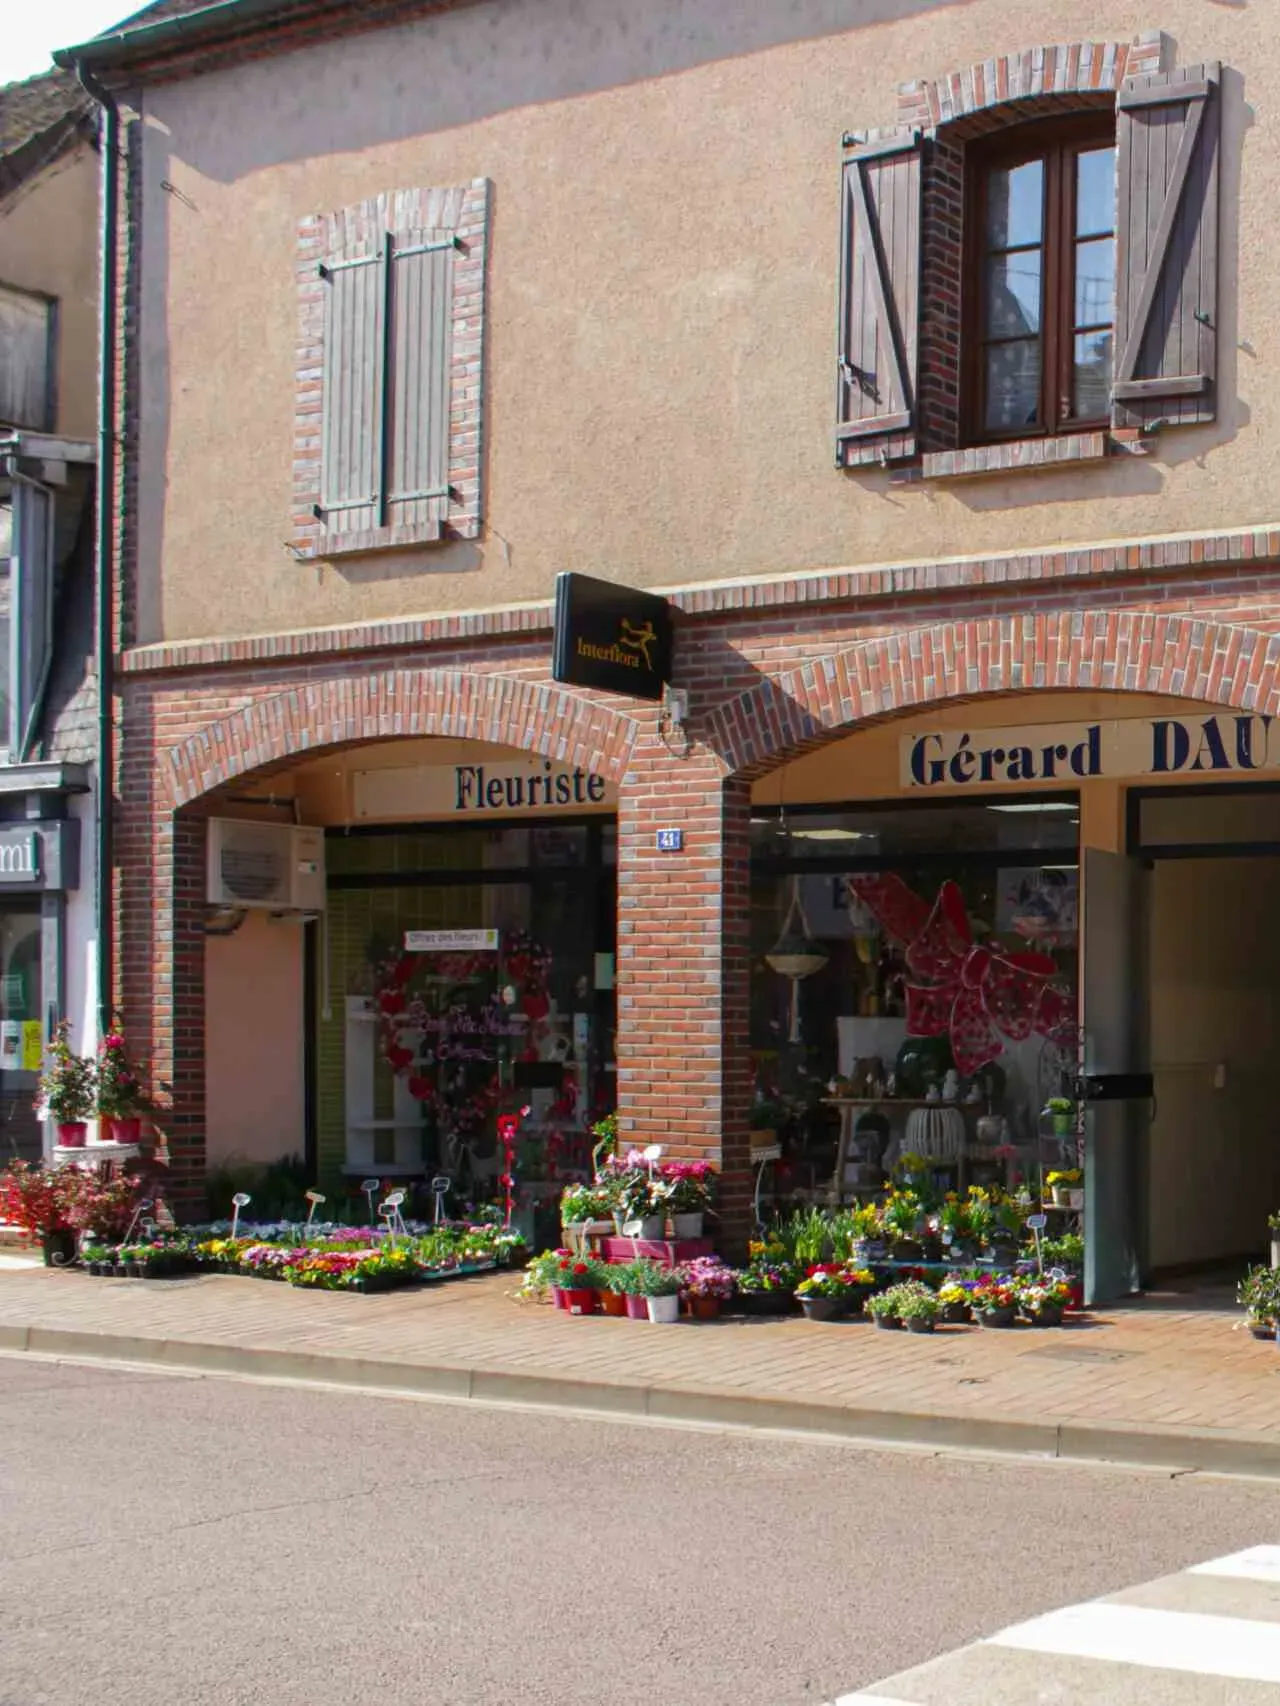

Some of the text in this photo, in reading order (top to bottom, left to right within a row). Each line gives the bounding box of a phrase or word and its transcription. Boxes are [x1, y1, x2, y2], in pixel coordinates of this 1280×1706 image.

[577, 636, 640, 669] Interflora
[911, 724, 1104, 786] Gérard
[455, 760, 605, 810] Fleuriste
